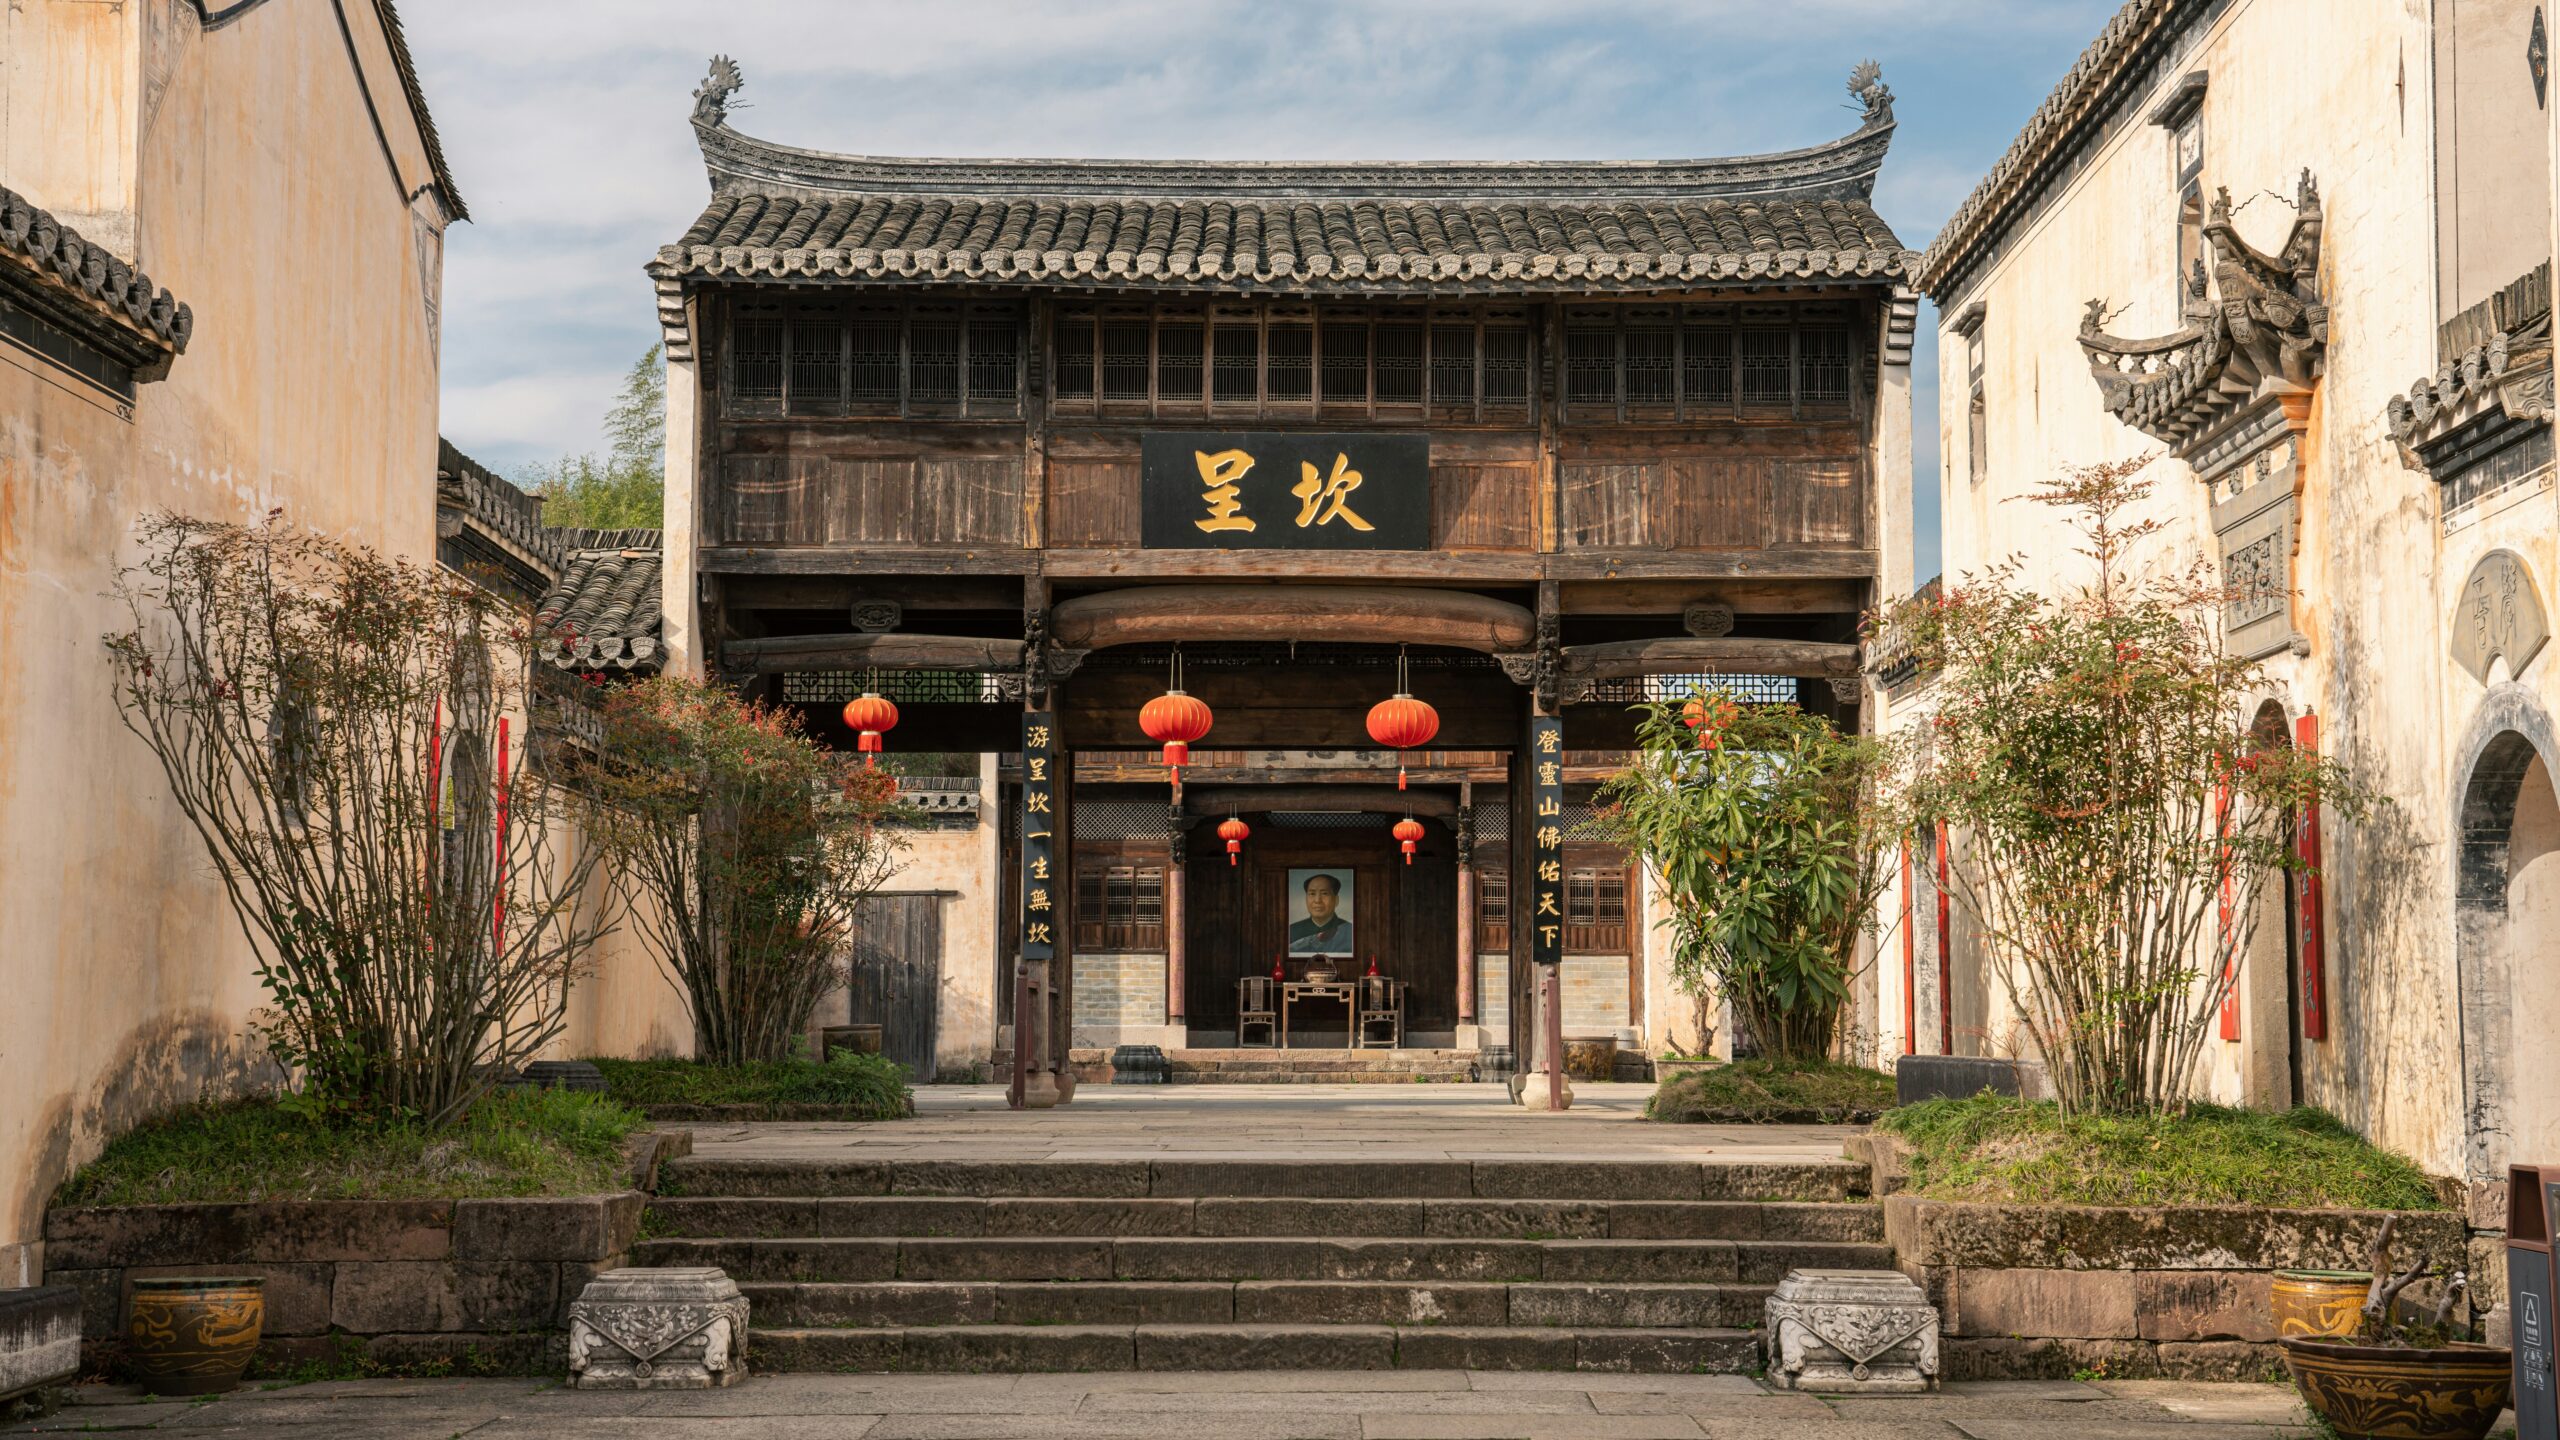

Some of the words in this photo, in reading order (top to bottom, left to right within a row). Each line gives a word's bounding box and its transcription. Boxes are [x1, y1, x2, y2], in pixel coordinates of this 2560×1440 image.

[1194, 448, 1377, 533] 呈坎
[1027, 725, 1052, 944] 游呈坎一生無坎
[1536, 729, 1562, 949] 登靈山佛佑天下
